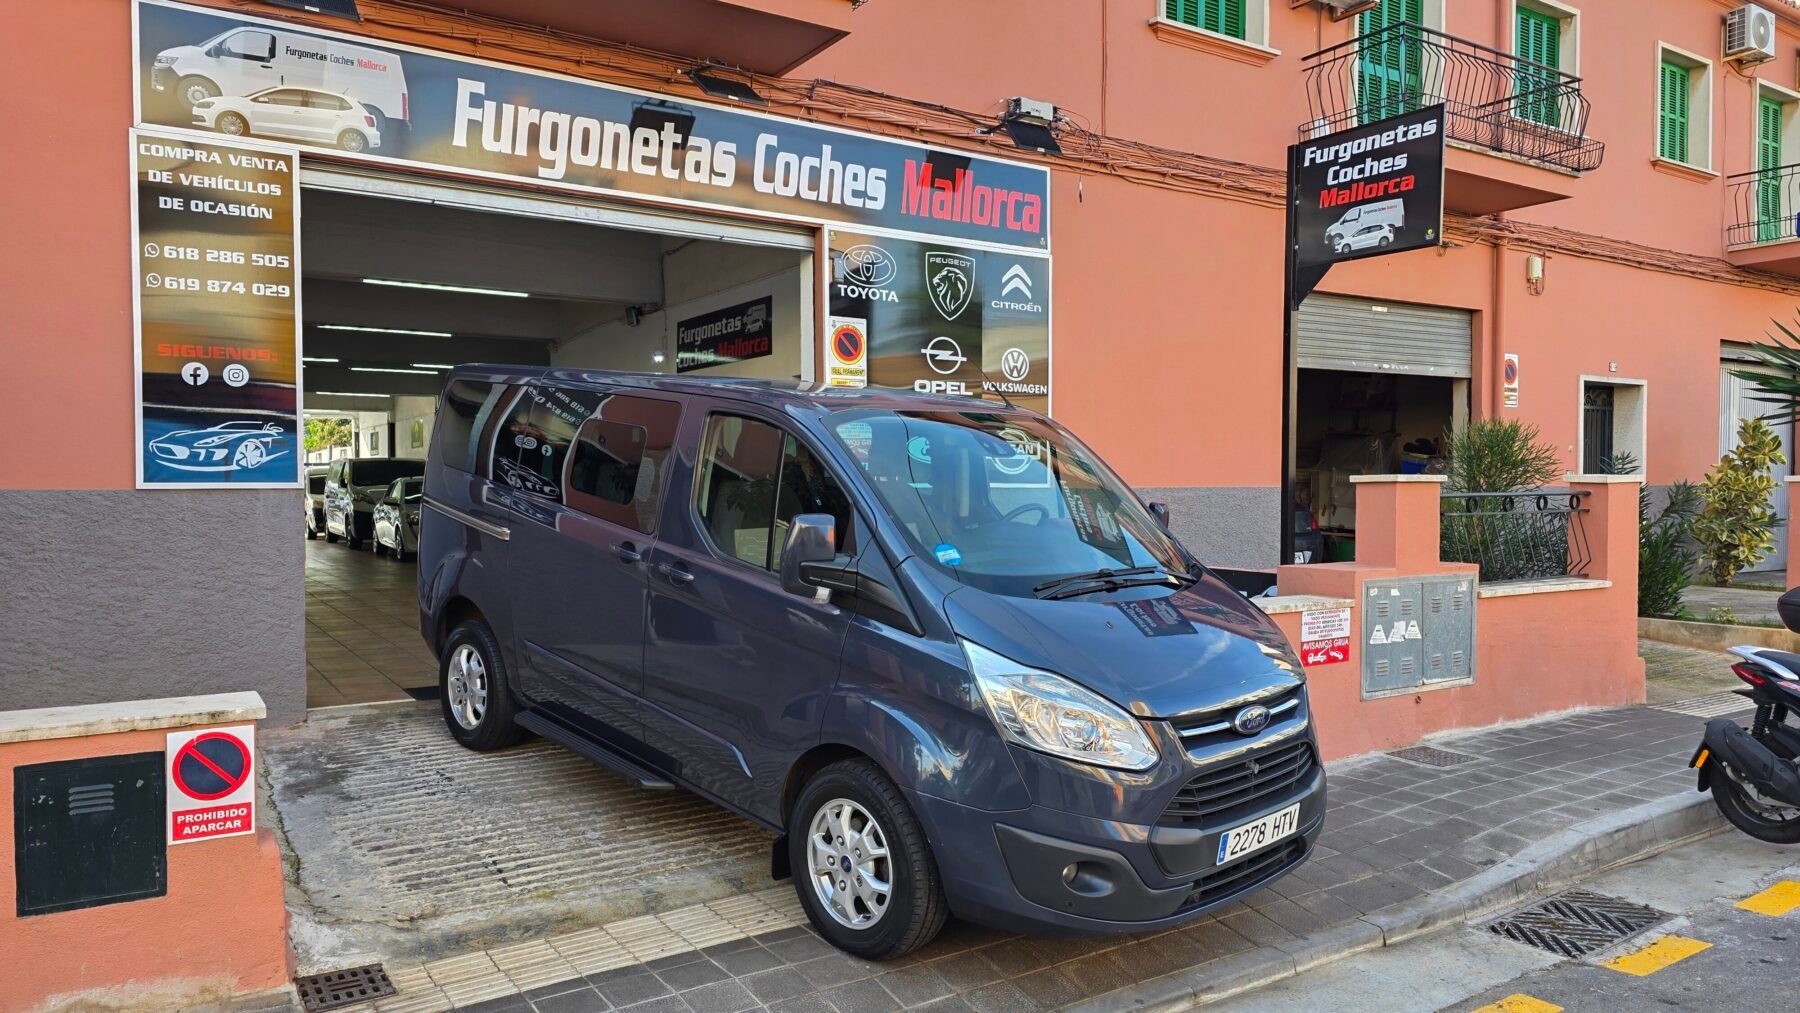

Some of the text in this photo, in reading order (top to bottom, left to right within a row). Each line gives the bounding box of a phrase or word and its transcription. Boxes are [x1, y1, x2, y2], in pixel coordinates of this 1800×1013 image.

[285, 45, 387, 72] Furgonetas Coches Mallorca
[1303, 118, 1438, 168] Furgonetas
[139, 143, 289, 173] COMPRA VENTA
[452, 77, 1042, 233] Furgonetas Coches Mallorca
[1326, 153, 1408, 186] Coches
[148, 169, 282, 196] DE VEHÍCULOS
[1319, 174, 1415, 209] Mallorca
[159, 196, 273, 220] DE OCASIÓN
[163, 245, 290, 268] 618 286 505
[929, 257, 972, 268] PEUGEOT
[164, 276, 291, 298] 619 874 029
[837, 284, 899, 303] TOYOTA
[678, 316, 742, 345] Furgonetas
[157, 342, 280, 363] SIGUENOS:
[717, 335, 769, 357] Mallorca
[914, 379, 974, 397] OPEL
[982, 380, 1048, 394] VOLKSWAGEN
[1302, 637, 1349, 651] AVISAMOS GRUA
[177, 807, 247, 825] PROHIBIDO
[182, 819, 242, 835] APARCAR
[1229, 808, 1297, 856] 2278 HTV
